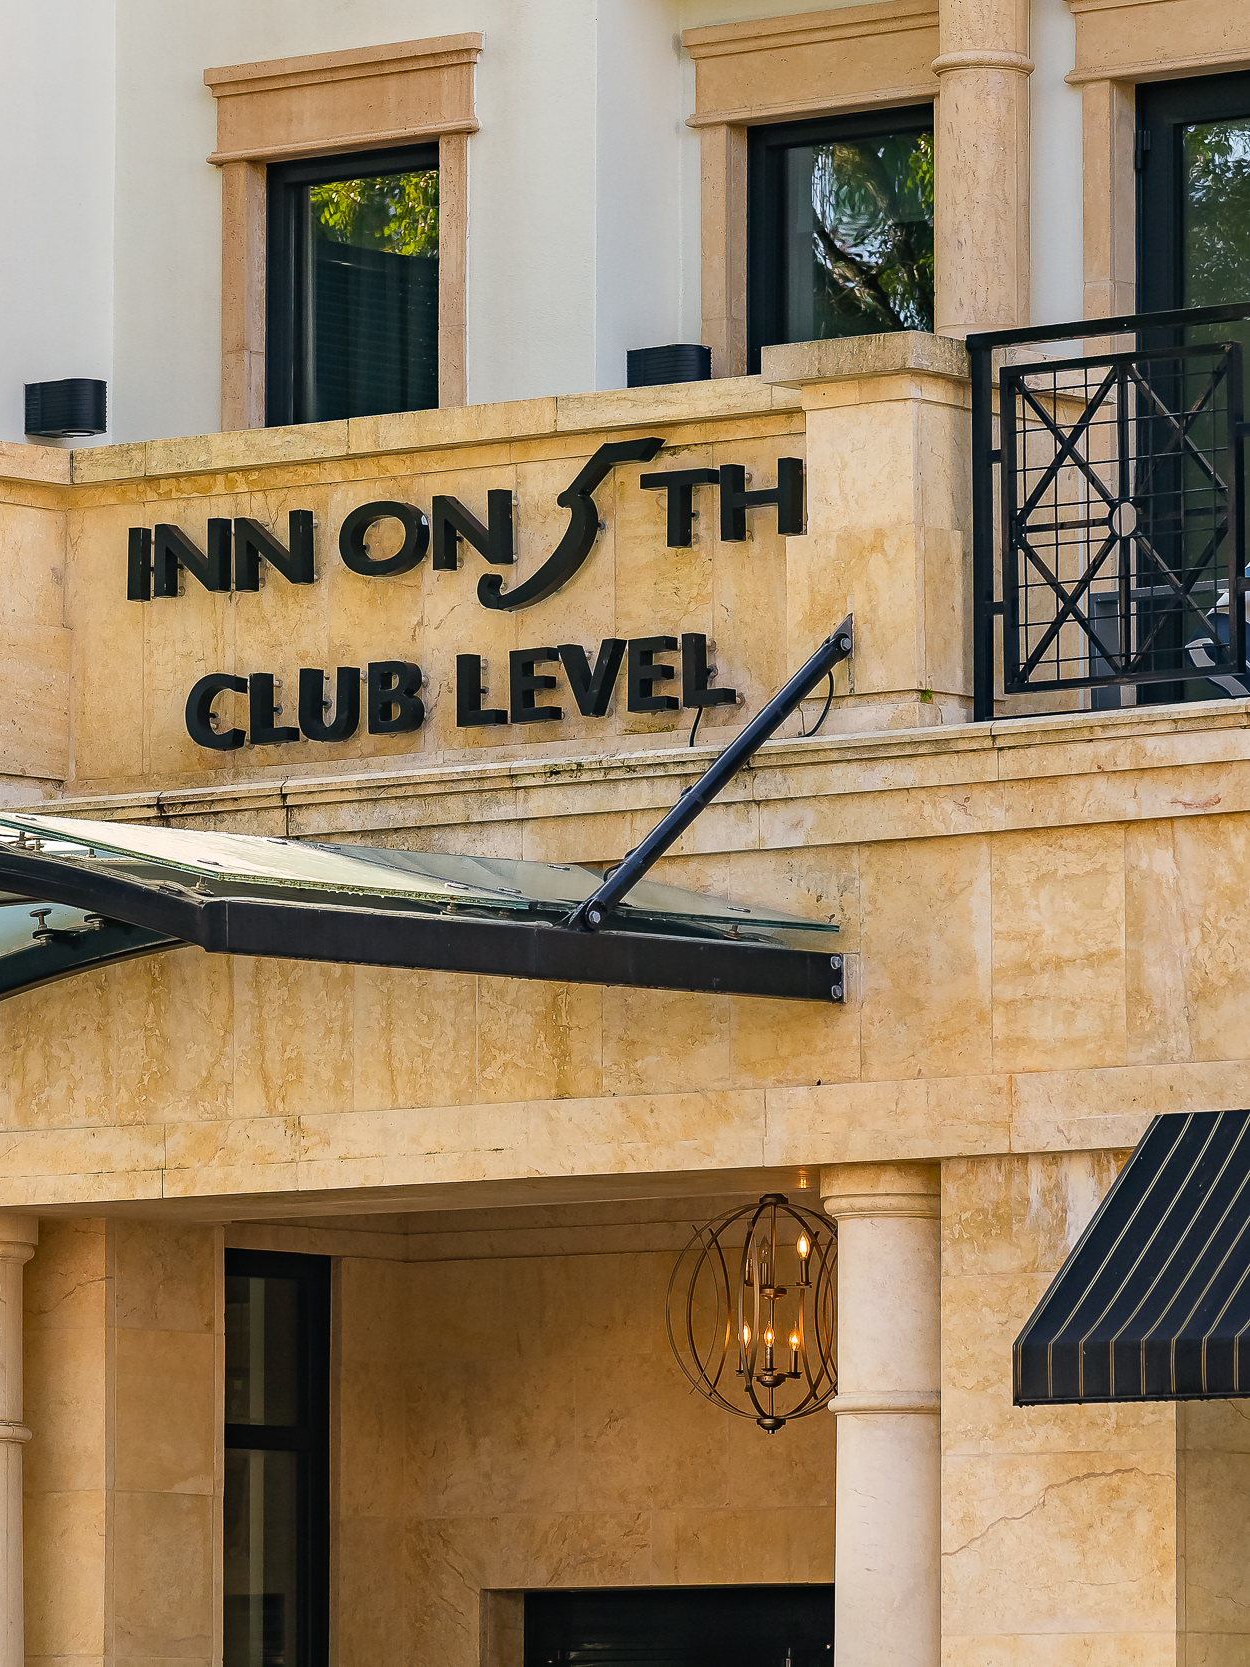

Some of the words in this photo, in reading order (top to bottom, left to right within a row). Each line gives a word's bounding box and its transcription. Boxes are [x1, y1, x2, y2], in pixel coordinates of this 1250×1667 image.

[127, 509, 314, 602] INN
[339, 488, 513, 578] ON
[477, 437, 807, 612] 5TH
[185, 660, 424, 751] CLUB
[455, 632, 737, 728] LEVEL
